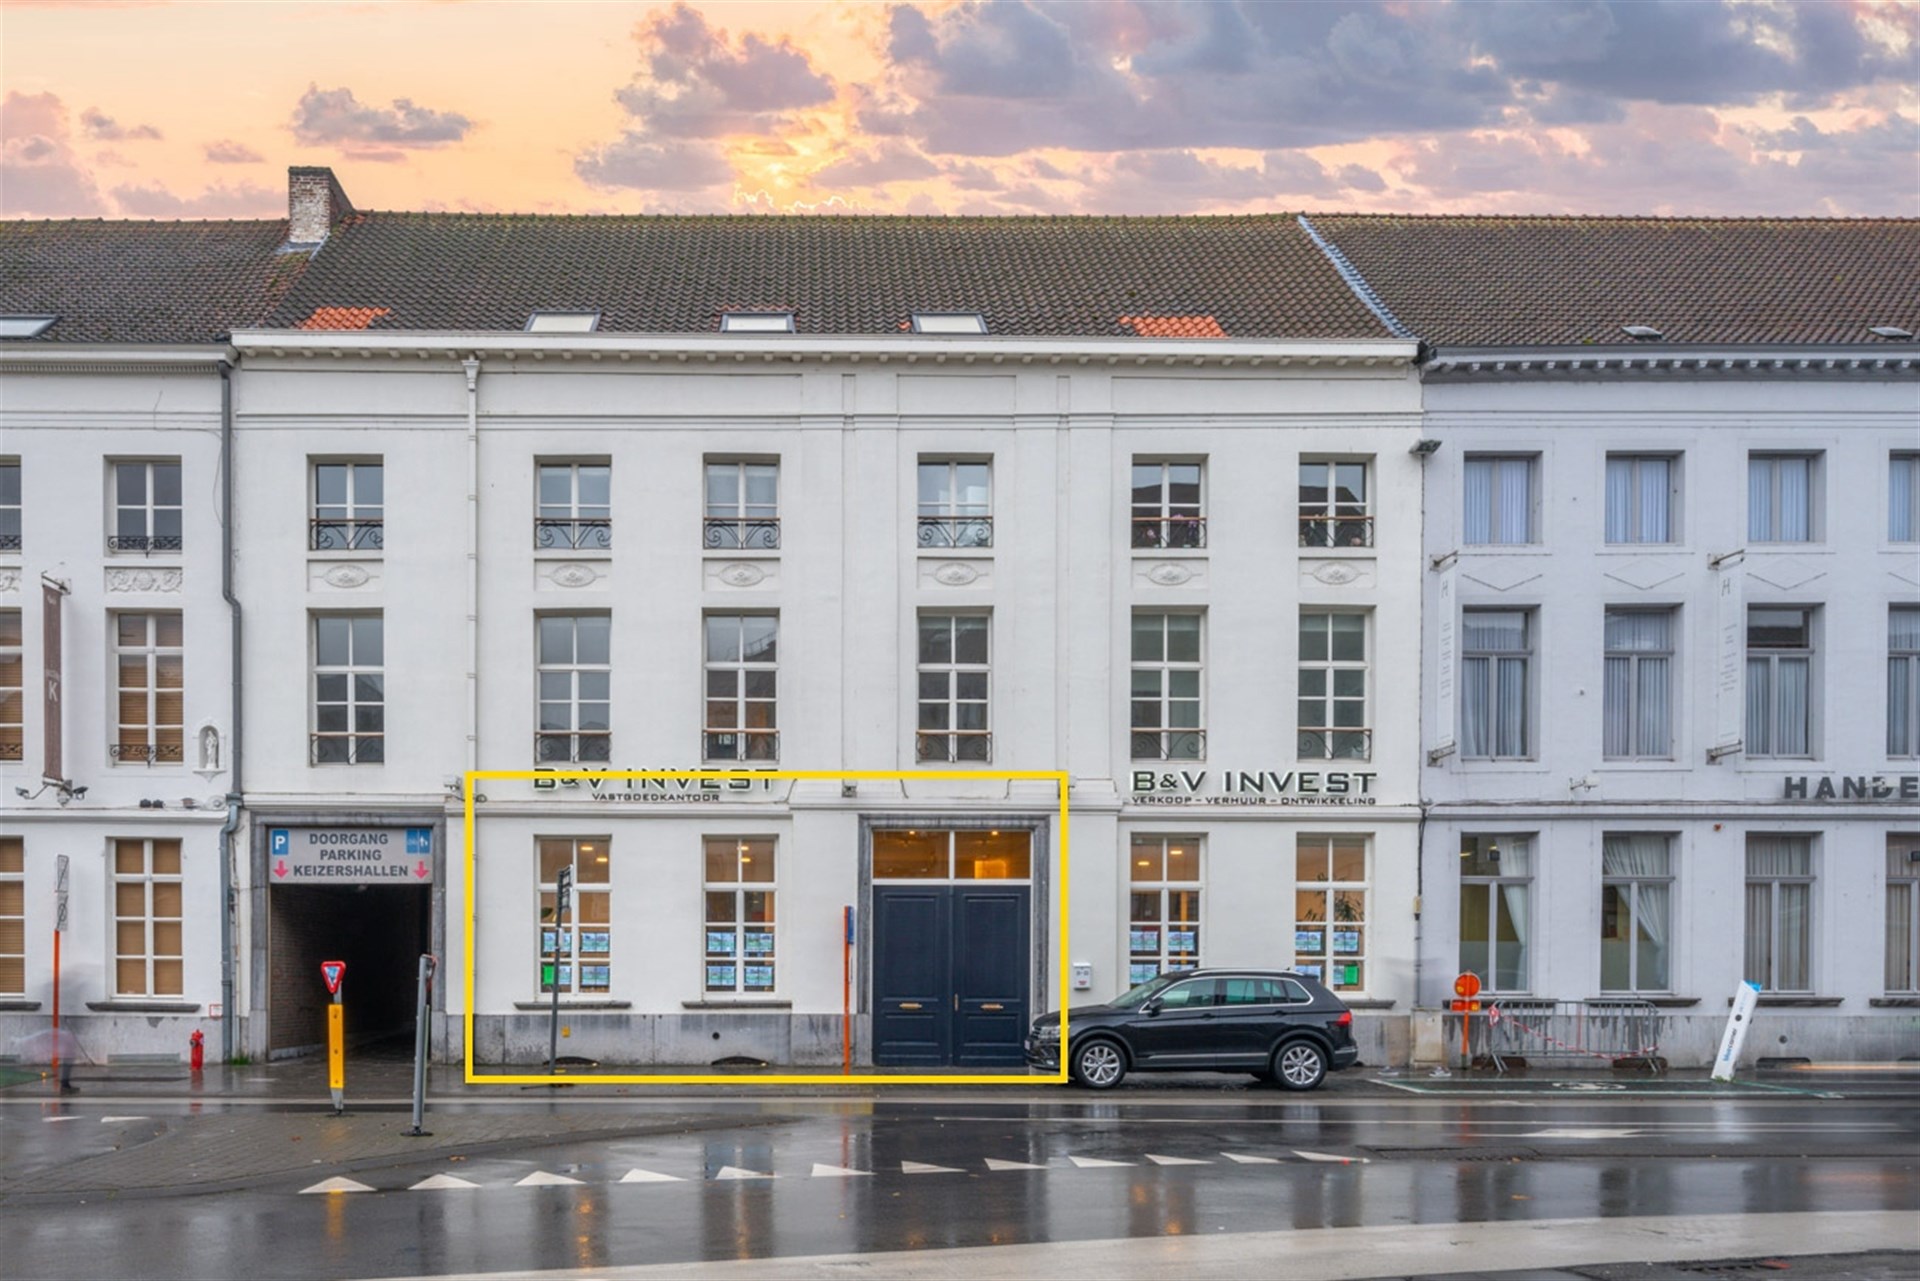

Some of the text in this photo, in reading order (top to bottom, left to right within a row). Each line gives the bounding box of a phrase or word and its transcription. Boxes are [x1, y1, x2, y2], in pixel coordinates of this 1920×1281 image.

[48, 679, 58, 702] K
[627, 768, 779, 790] INVEST
[1132, 771, 1377, 793] B&V INVEST
[1784, 776, 1919, 799] HANDE
[592, 793, 720, 801] VASTGOEDKANTOOR
[1132, 796, 1192, 804] VERKOOP
[1205, 796, 1266, 805] VERHUUR
[1281, 797, 1376, 805] ONTWIKKELING
[275, 835, 286, 850] P
[309, 833, 389, 845] DOORGANG
[320, 849, 382, 861] PARKING
[293, 865, 408, 877] KEIZERSHALLEN
